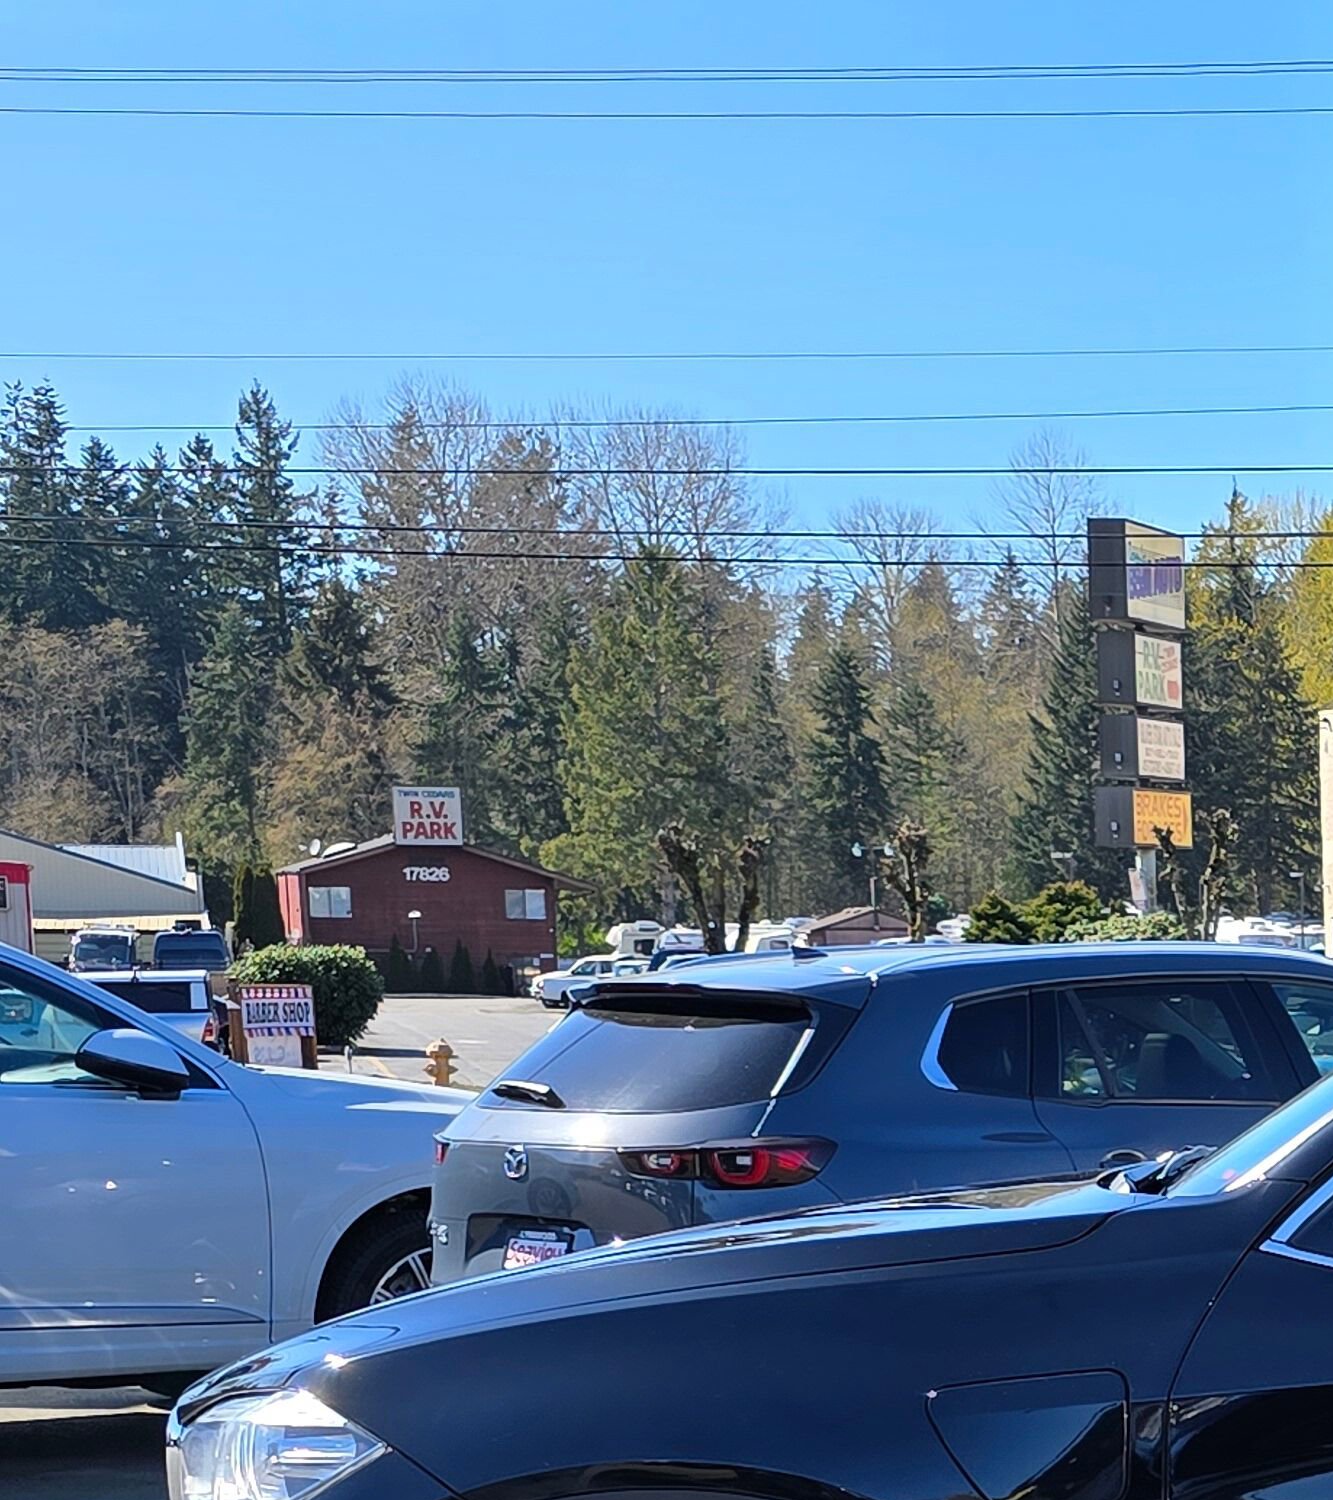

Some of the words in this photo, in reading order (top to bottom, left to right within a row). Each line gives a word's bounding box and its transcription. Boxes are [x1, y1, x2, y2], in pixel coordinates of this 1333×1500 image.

[409, 801, 449, 819] R.V.
[1136, 793, 1181, 819] BRAKES
[401, 821, 458, 840] PARK
[402, 866, 451, 881] 17826
[245, 1002, 280, 1024] BARBER
[282, 1001, 311, 1023] SHOP
